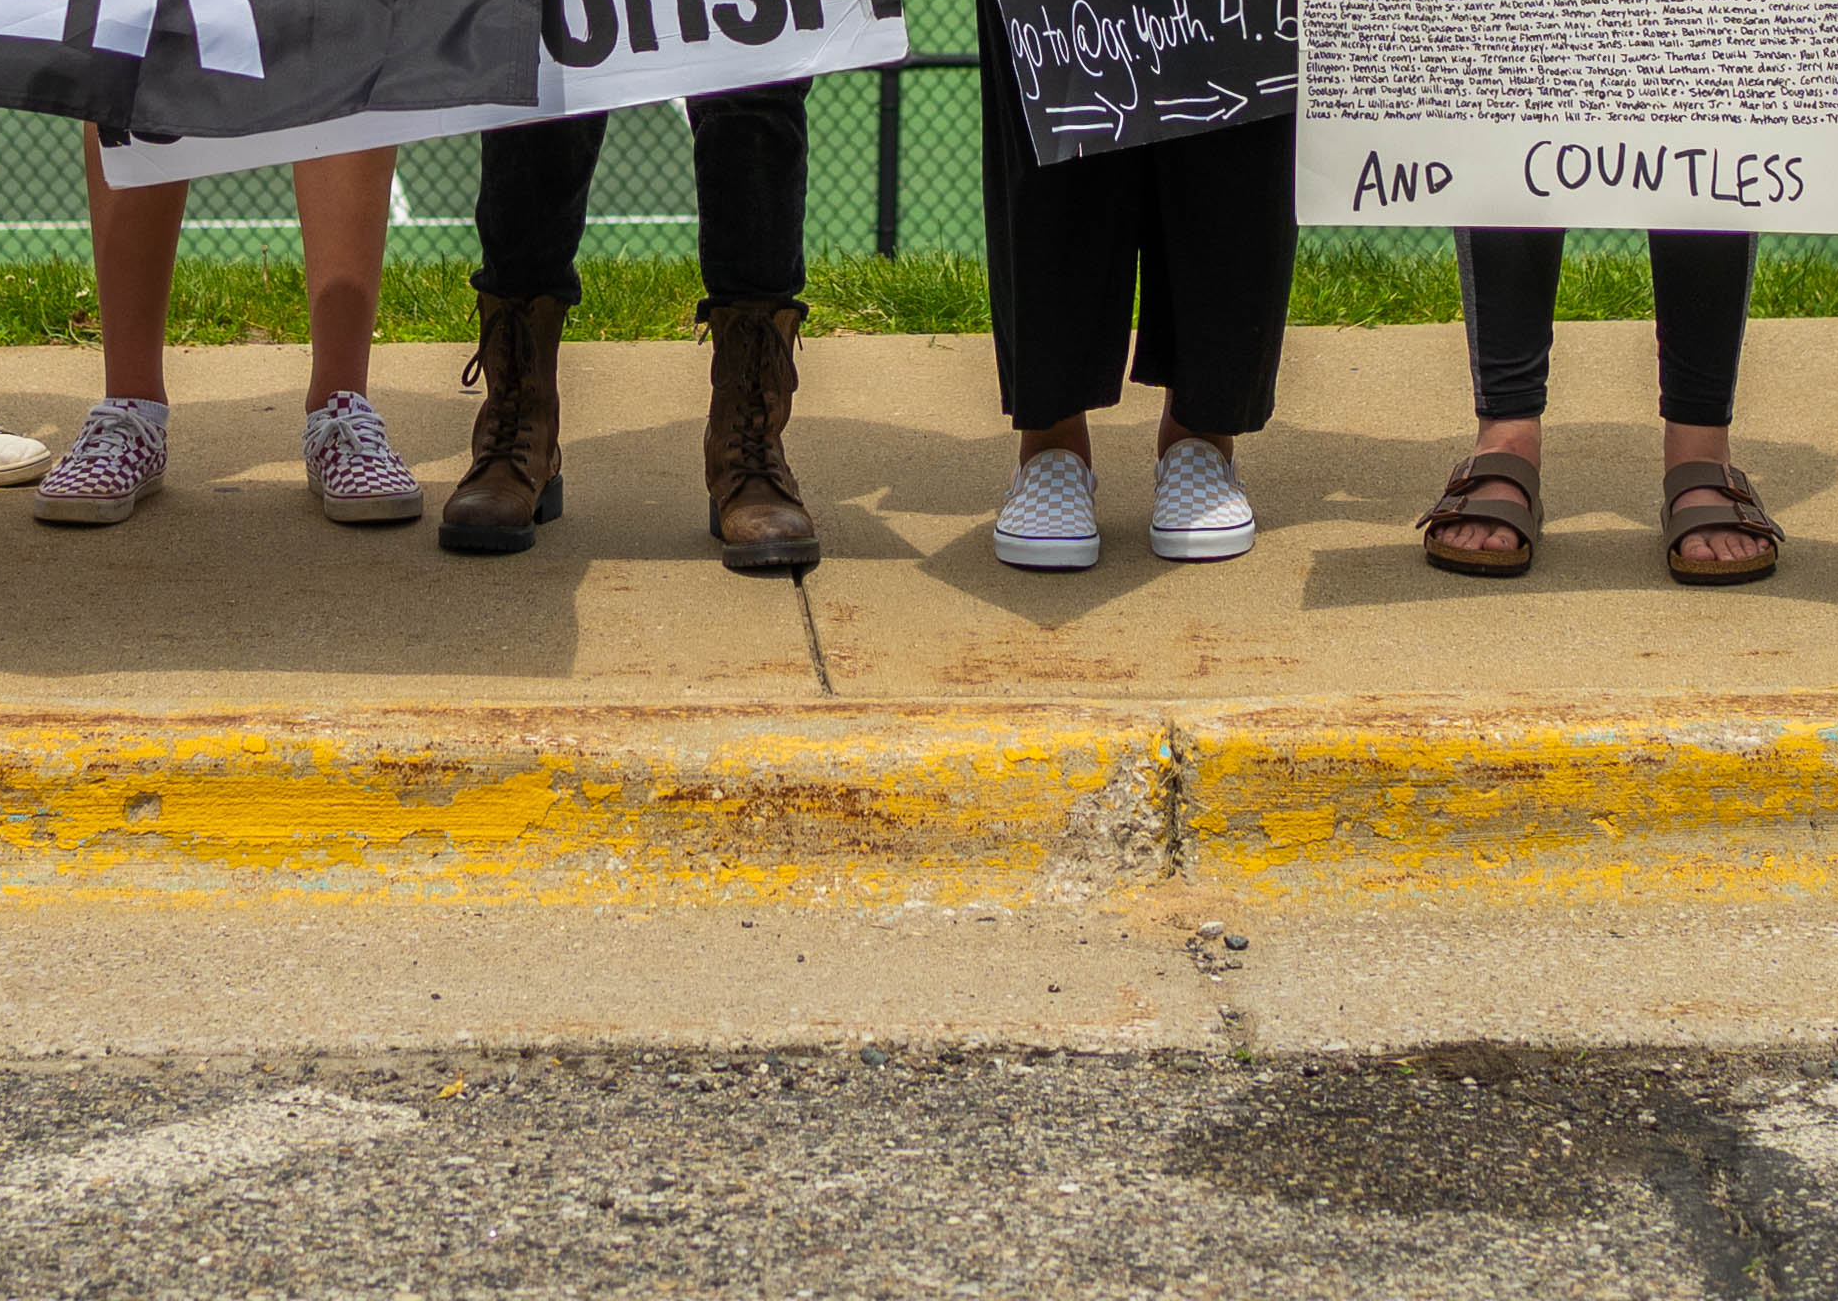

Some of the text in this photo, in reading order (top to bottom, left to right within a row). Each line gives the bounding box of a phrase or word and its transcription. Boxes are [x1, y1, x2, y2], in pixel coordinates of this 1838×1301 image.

[1011, 18, 1042, 101] go
[1042, 5, 1069, 66] to
[1306, 109, 1331, 119] Lucas
[1383, 110, 1422, 120] Anthony
[1426, 109, 1467, 120] Williams
[1478, 108, 1516, 123] Gregory
[1565, 111, 1580, 121] Hill
[1651, 113, 1688, 123] Dexter
[1750, 113, 1788, 125] Anthony
[1792, 115, 1818, 125] Bess
[1354, 150, 1452, 210] AND
[1524, 140, 1804, 208] COUNTLESS
